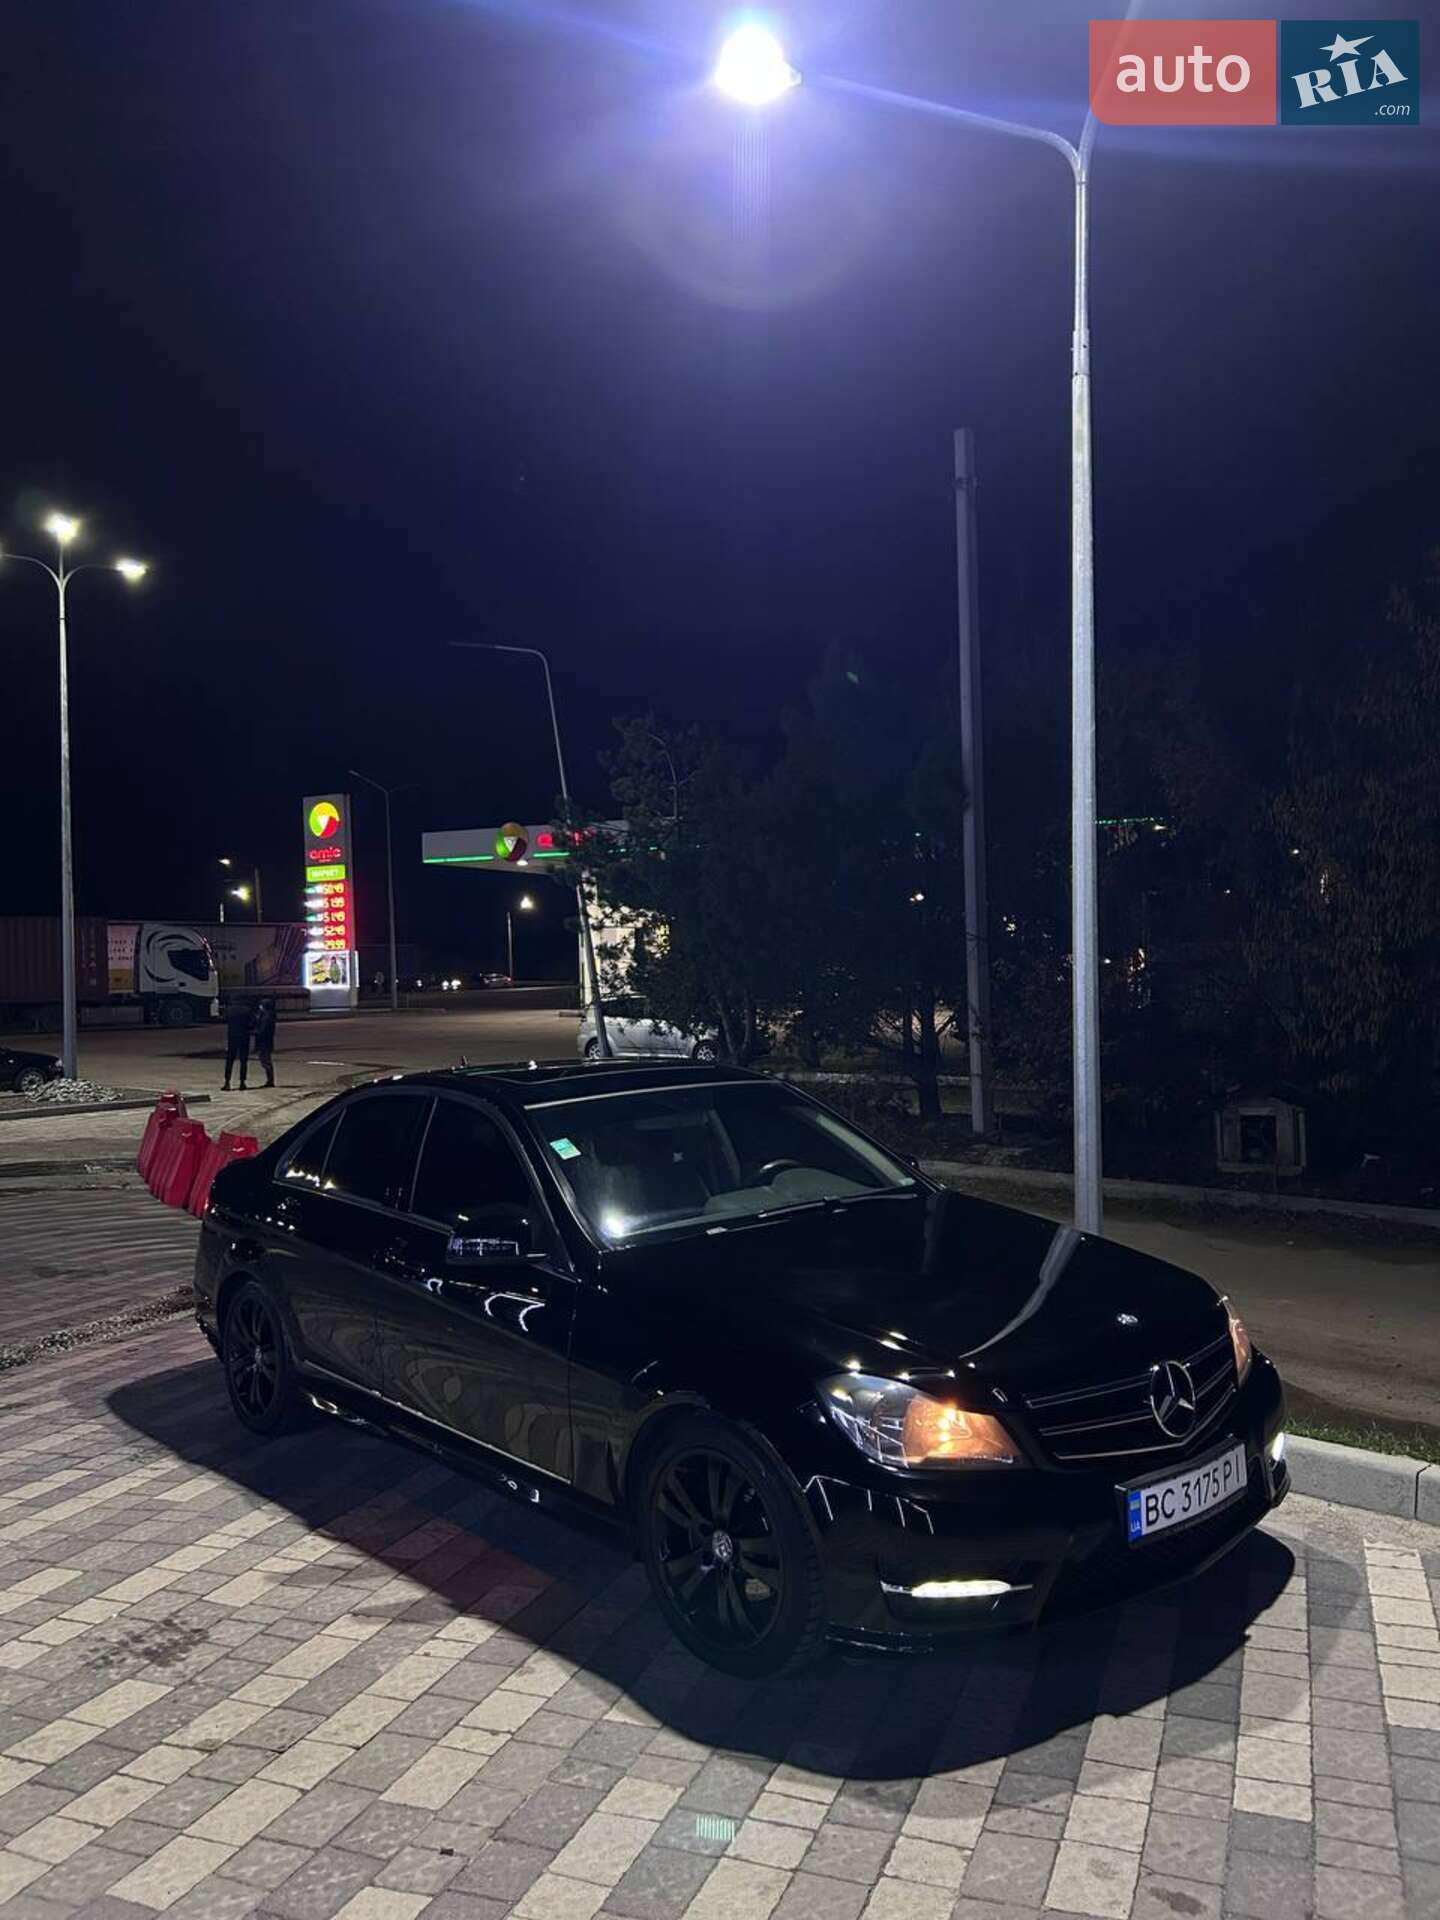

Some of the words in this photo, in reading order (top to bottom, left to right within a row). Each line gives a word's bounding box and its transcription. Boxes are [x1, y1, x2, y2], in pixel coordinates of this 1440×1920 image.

[1145, 1488, 1176, 1527] BC
[1181, 1467, 1220, 1512] 3175
[1223, 1454, 1240, 1492] PI
